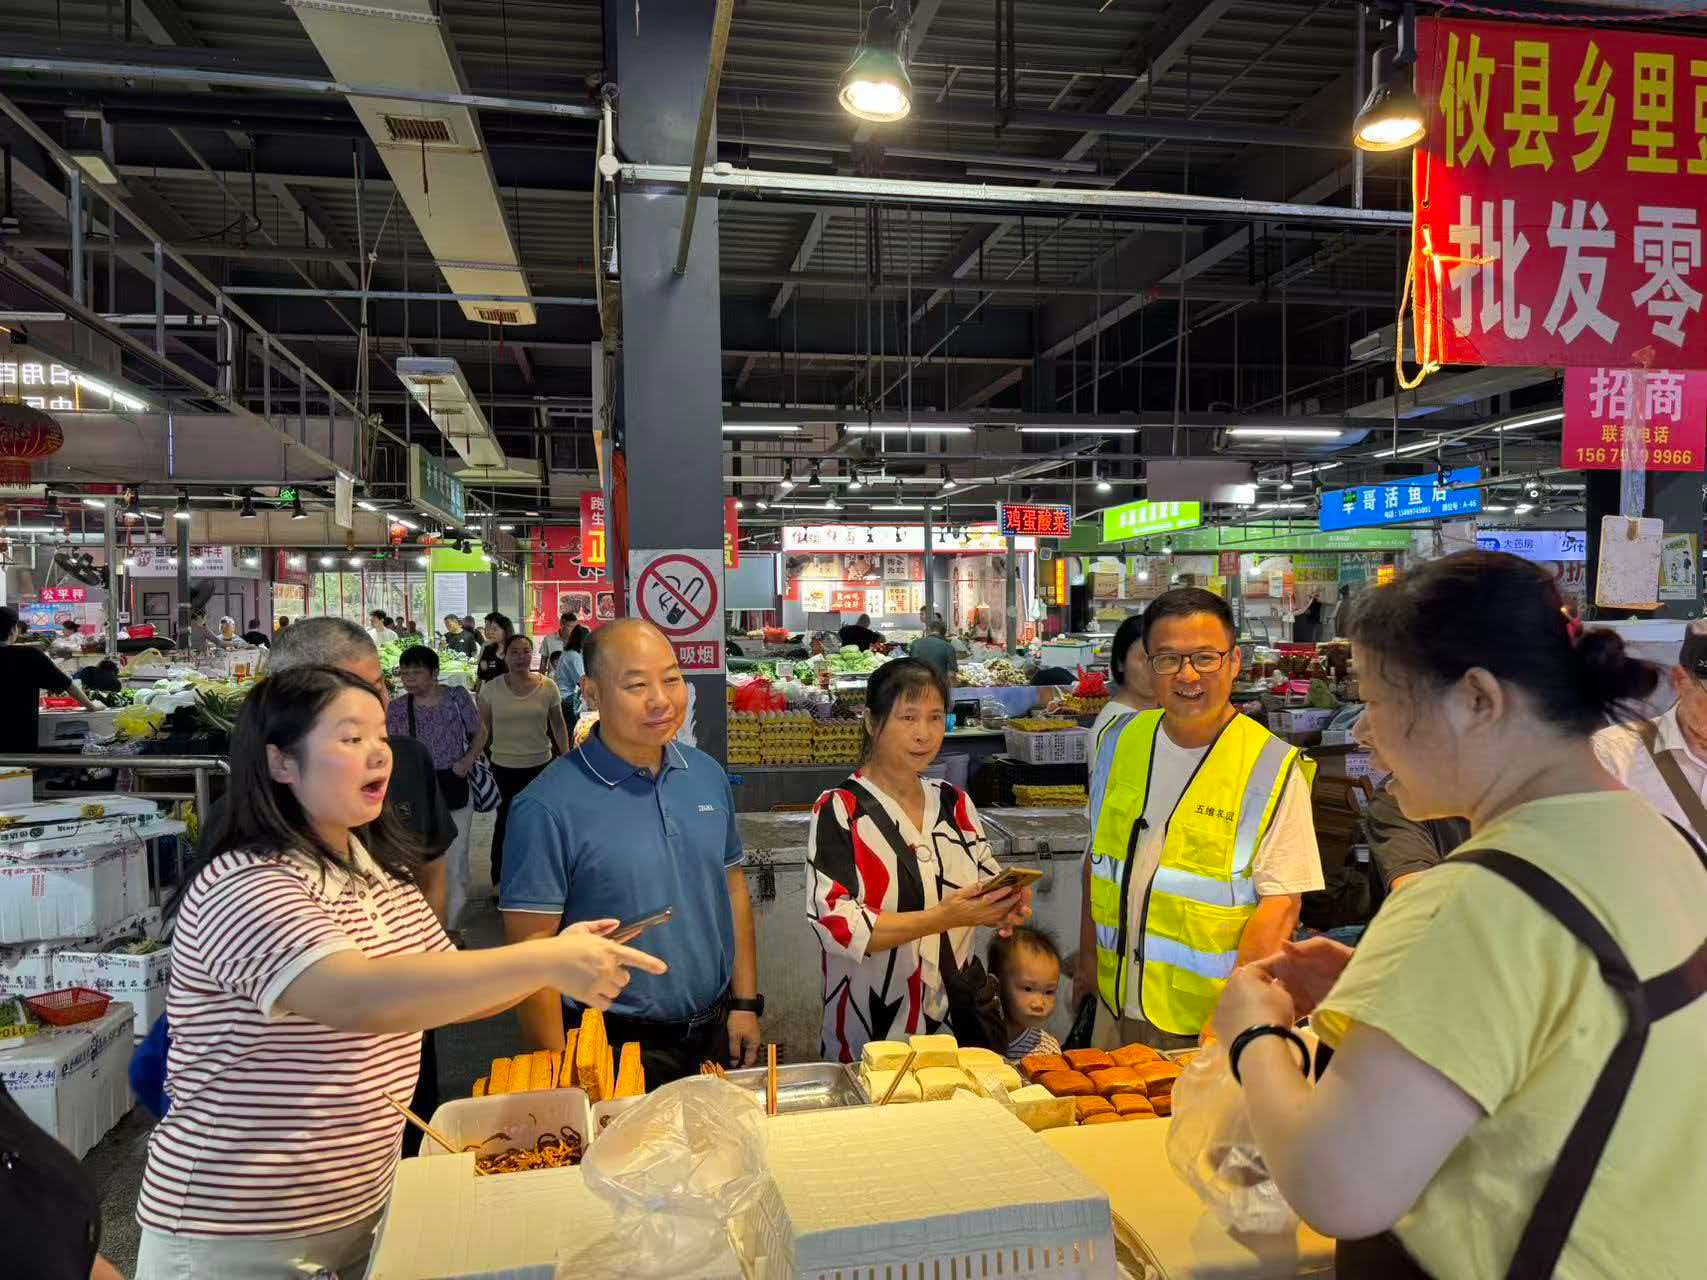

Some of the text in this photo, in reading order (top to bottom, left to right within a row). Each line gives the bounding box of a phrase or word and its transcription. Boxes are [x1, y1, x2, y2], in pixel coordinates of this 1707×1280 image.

[1448, 194, 1704, 348] 批发零
[1589, 368, 1686, 421] 招商
[1577, 448, 1606, 463] 156
[1653, 449, 1692, 465] 9966
[1006, 508, 1067, 532] 鸡蛋酸菜
[680, 645, 714, 665] 吸烟
